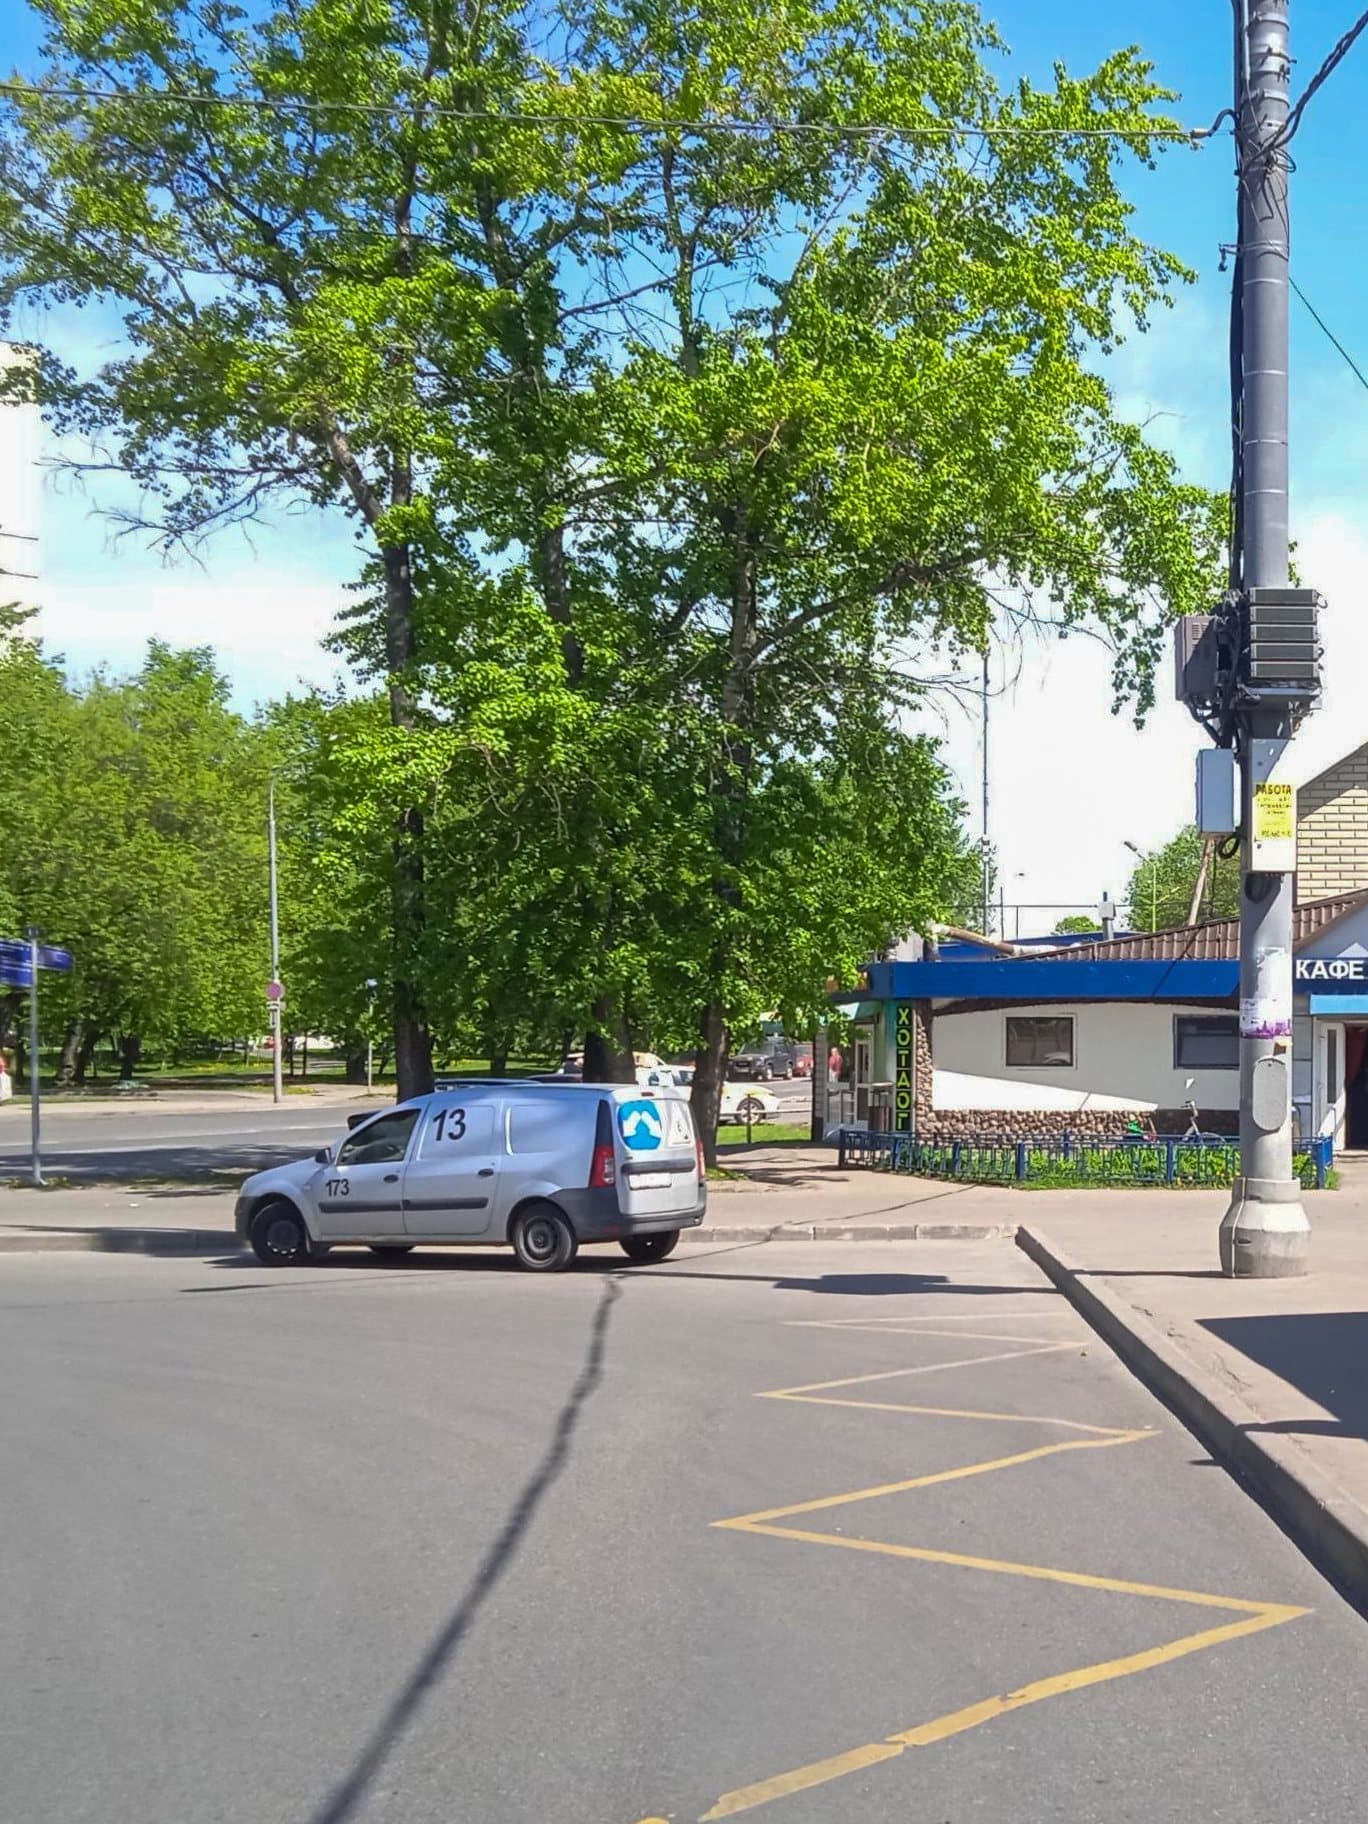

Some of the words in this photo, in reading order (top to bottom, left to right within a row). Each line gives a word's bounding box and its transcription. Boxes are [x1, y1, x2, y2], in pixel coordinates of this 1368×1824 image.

[1255, 784, 1292, 795] РАБОТА
[1295, 959, 1365, 979] КАФЕ
[433, 1108, 466, 1141] 13
[325, 1178, 350, 1196] 173
